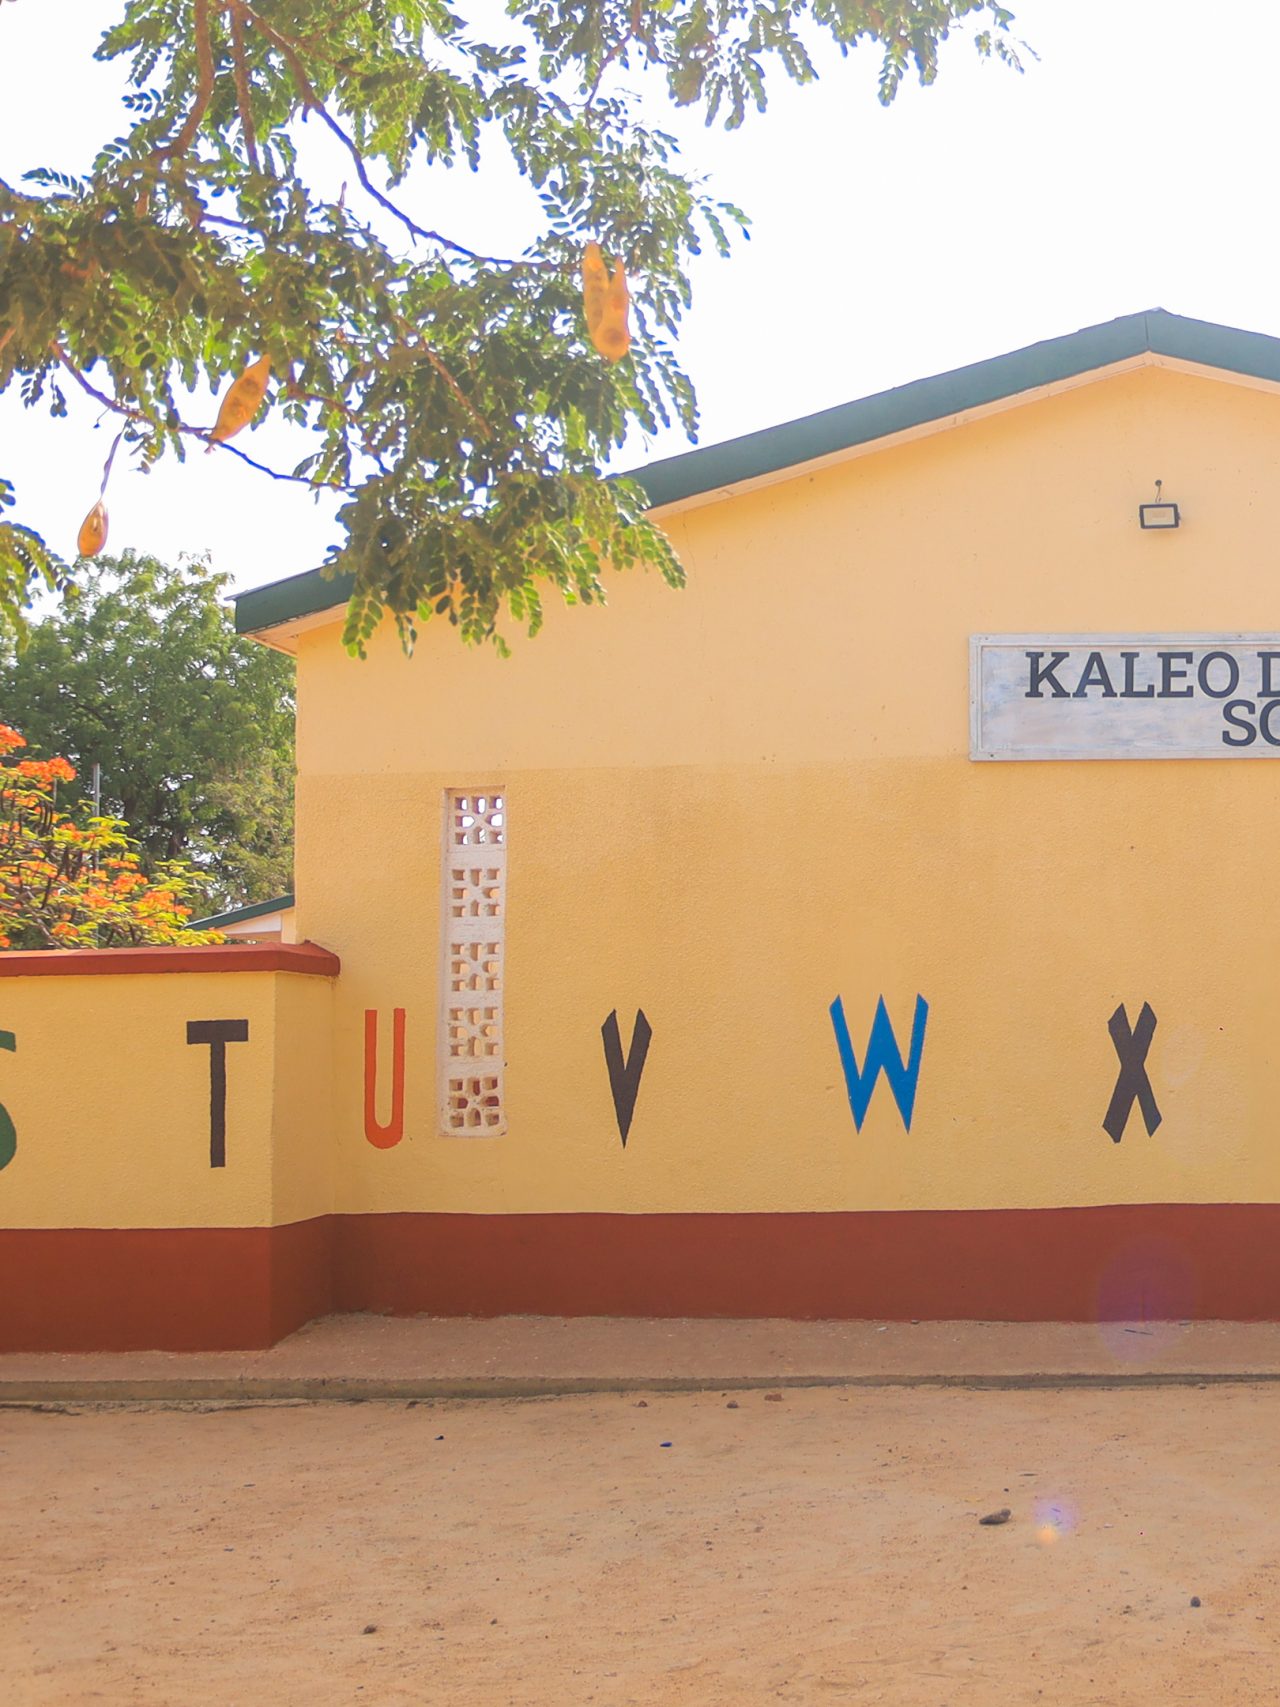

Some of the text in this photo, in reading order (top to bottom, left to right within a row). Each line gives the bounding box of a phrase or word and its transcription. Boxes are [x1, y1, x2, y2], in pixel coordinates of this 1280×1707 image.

[1025, 650, 1240, 699] KALEO
[186, 1019, 249, 1168] T
[364, 1008, 405, 1149] U
[601, 1008, 652, 1149] V
[829, 993, 929, 1135] W
[1102, 1001, 1162, 1144] X
